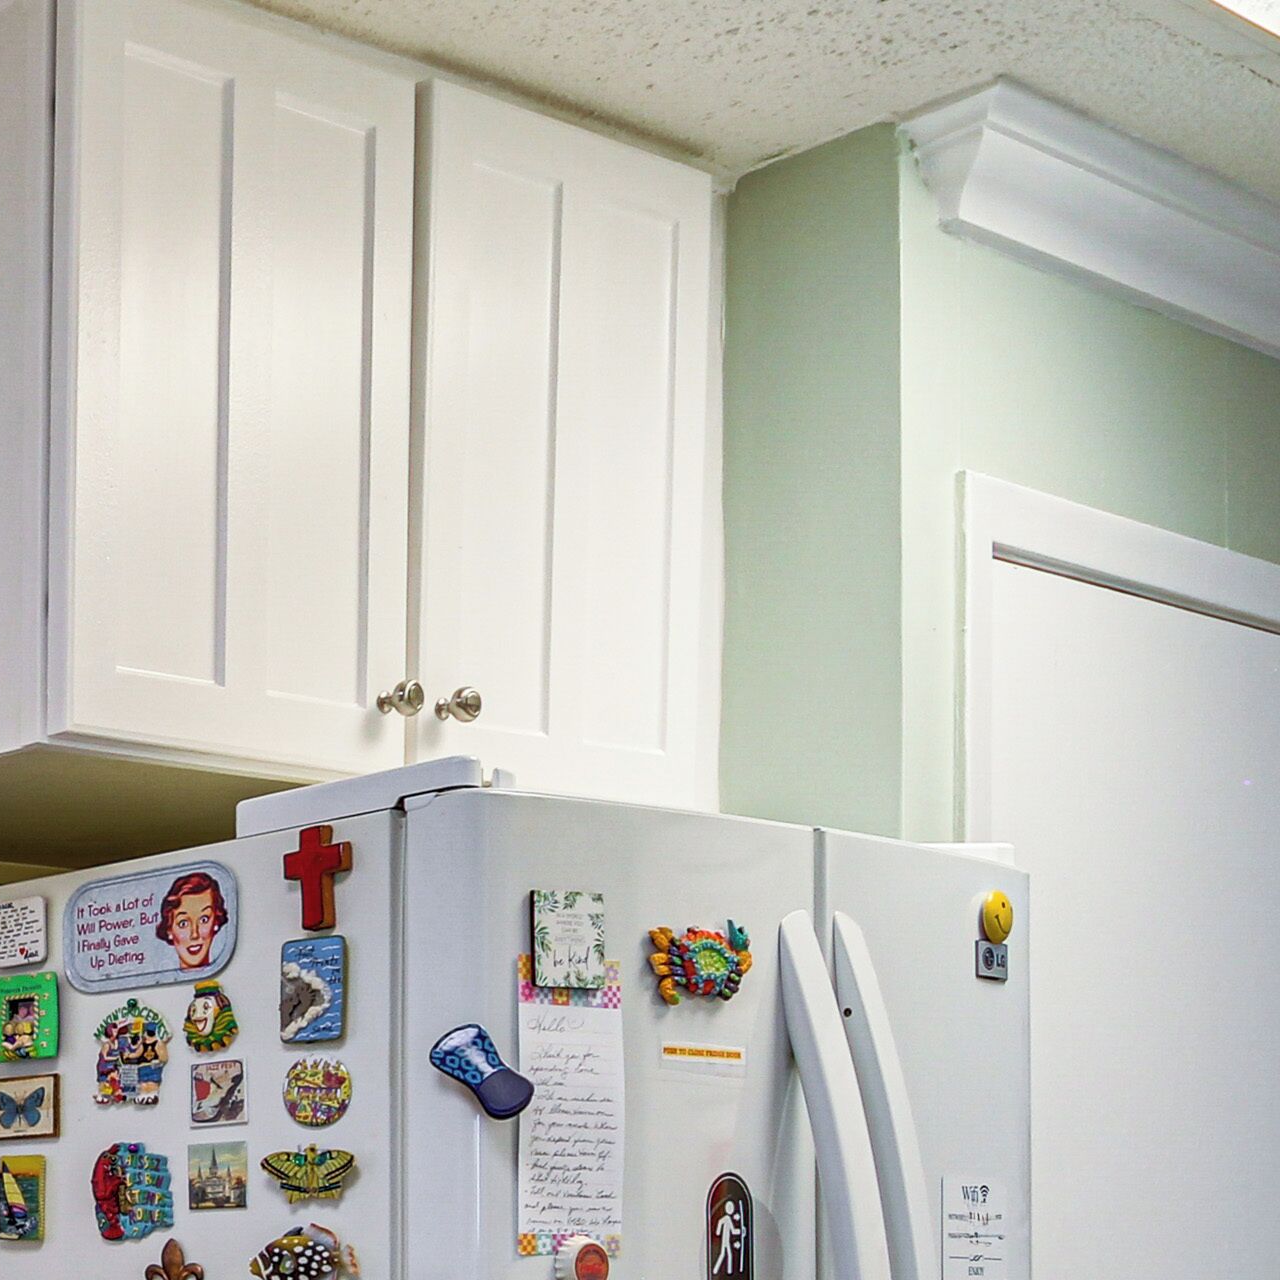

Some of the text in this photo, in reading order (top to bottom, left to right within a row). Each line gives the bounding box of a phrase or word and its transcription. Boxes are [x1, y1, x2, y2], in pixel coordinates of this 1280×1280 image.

[76, 893, 154, 919] It Took a Lot of
[77, 922, 96, 936] Will
[140, 912, 159, 925] But
[82, 937, 111, 952] Finally
[114, 934, 139, 947] Gave
[90, 956, 105, 970] Up
[996, 953, 1006, 968] LG
[527, 1010, 566, 1034] Hello
